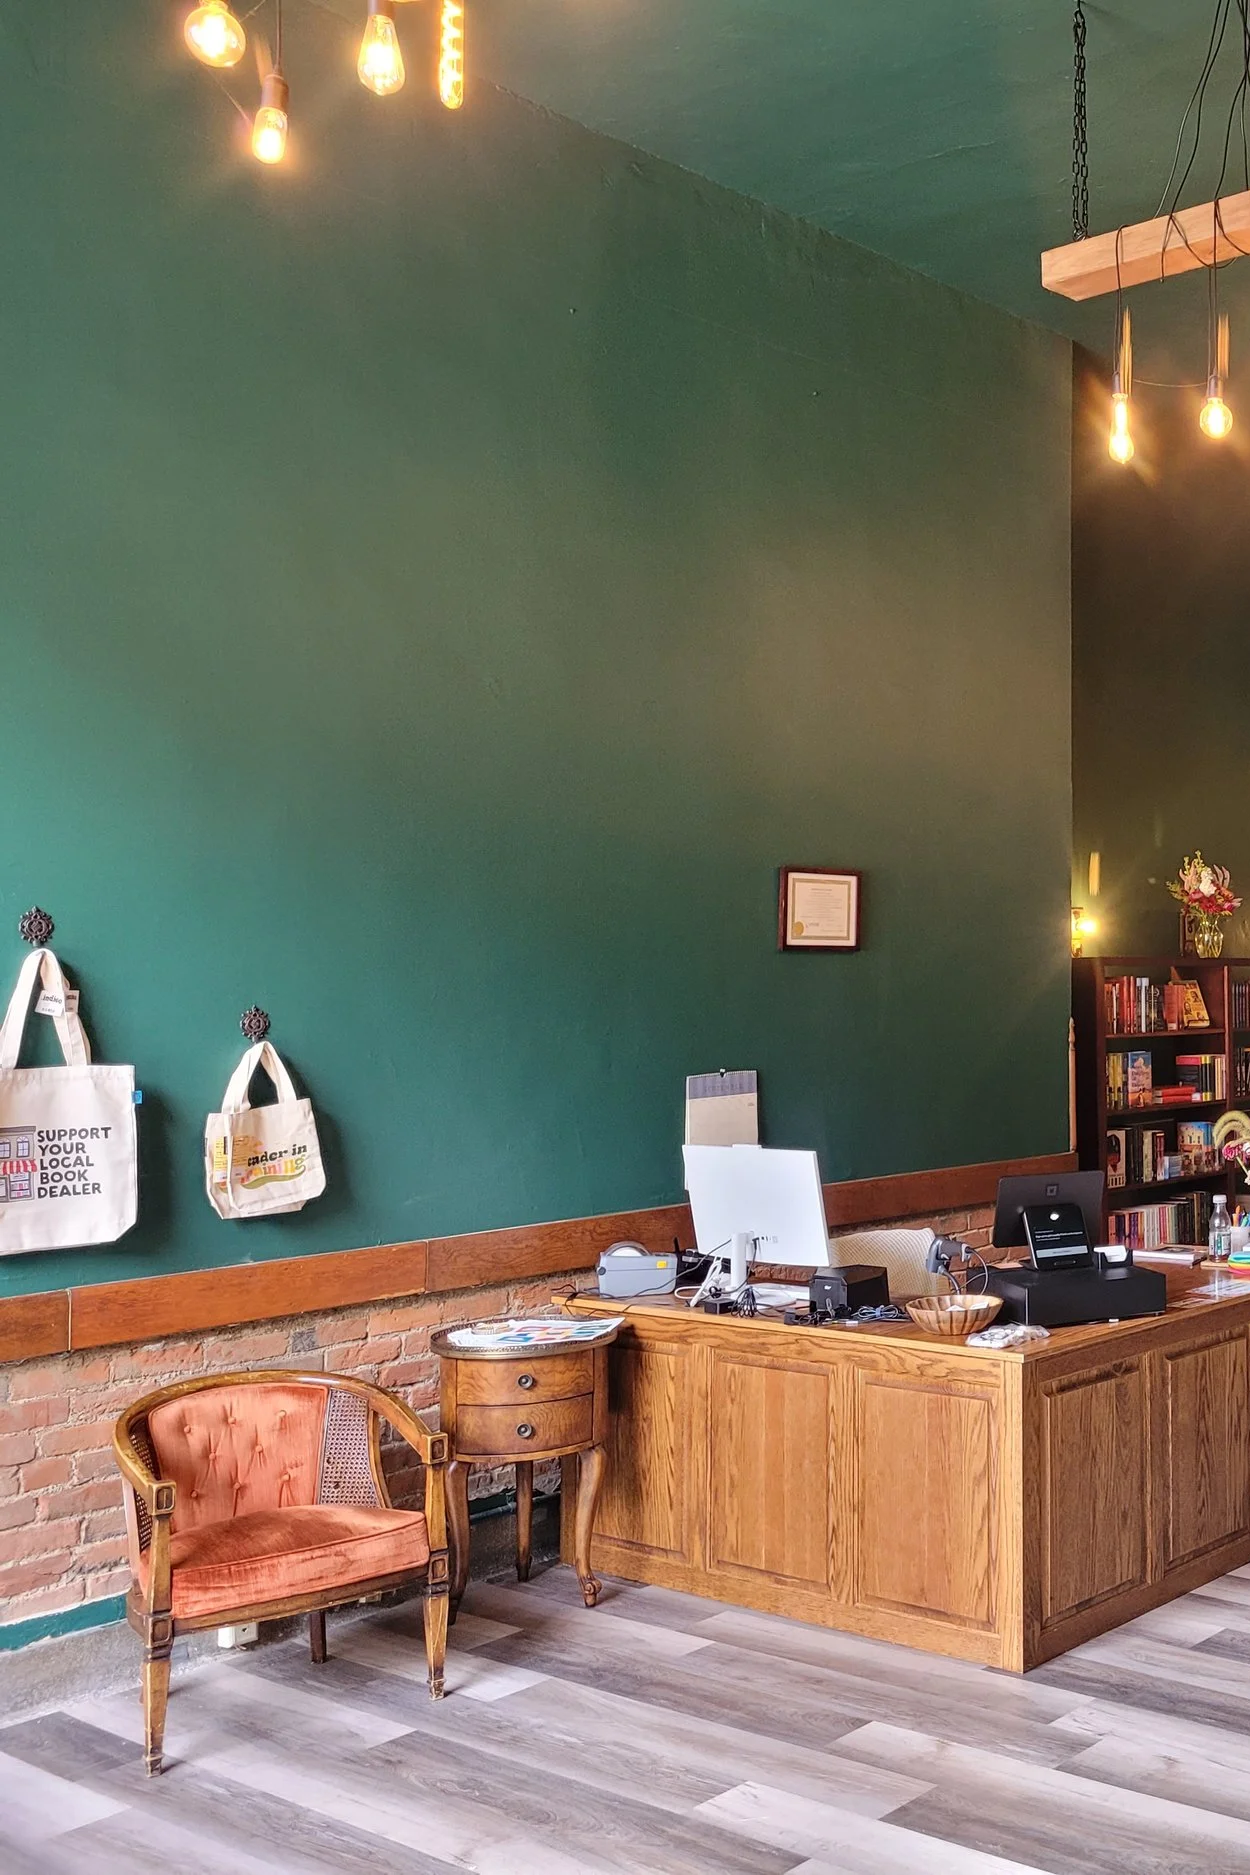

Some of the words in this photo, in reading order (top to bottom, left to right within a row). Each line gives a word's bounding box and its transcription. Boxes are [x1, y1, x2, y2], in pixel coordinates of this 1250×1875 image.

[37, 1127, 112, 1142] SUPPORT
[38, 1142, 86, 1156] YOUR
[292, 1144, 307, 1156] in
[39, 1156, 94, 1170] LOCAL
[40, 1169, 88, 1185] BOOK
[37, 1182, 102, 1199] DEALER
